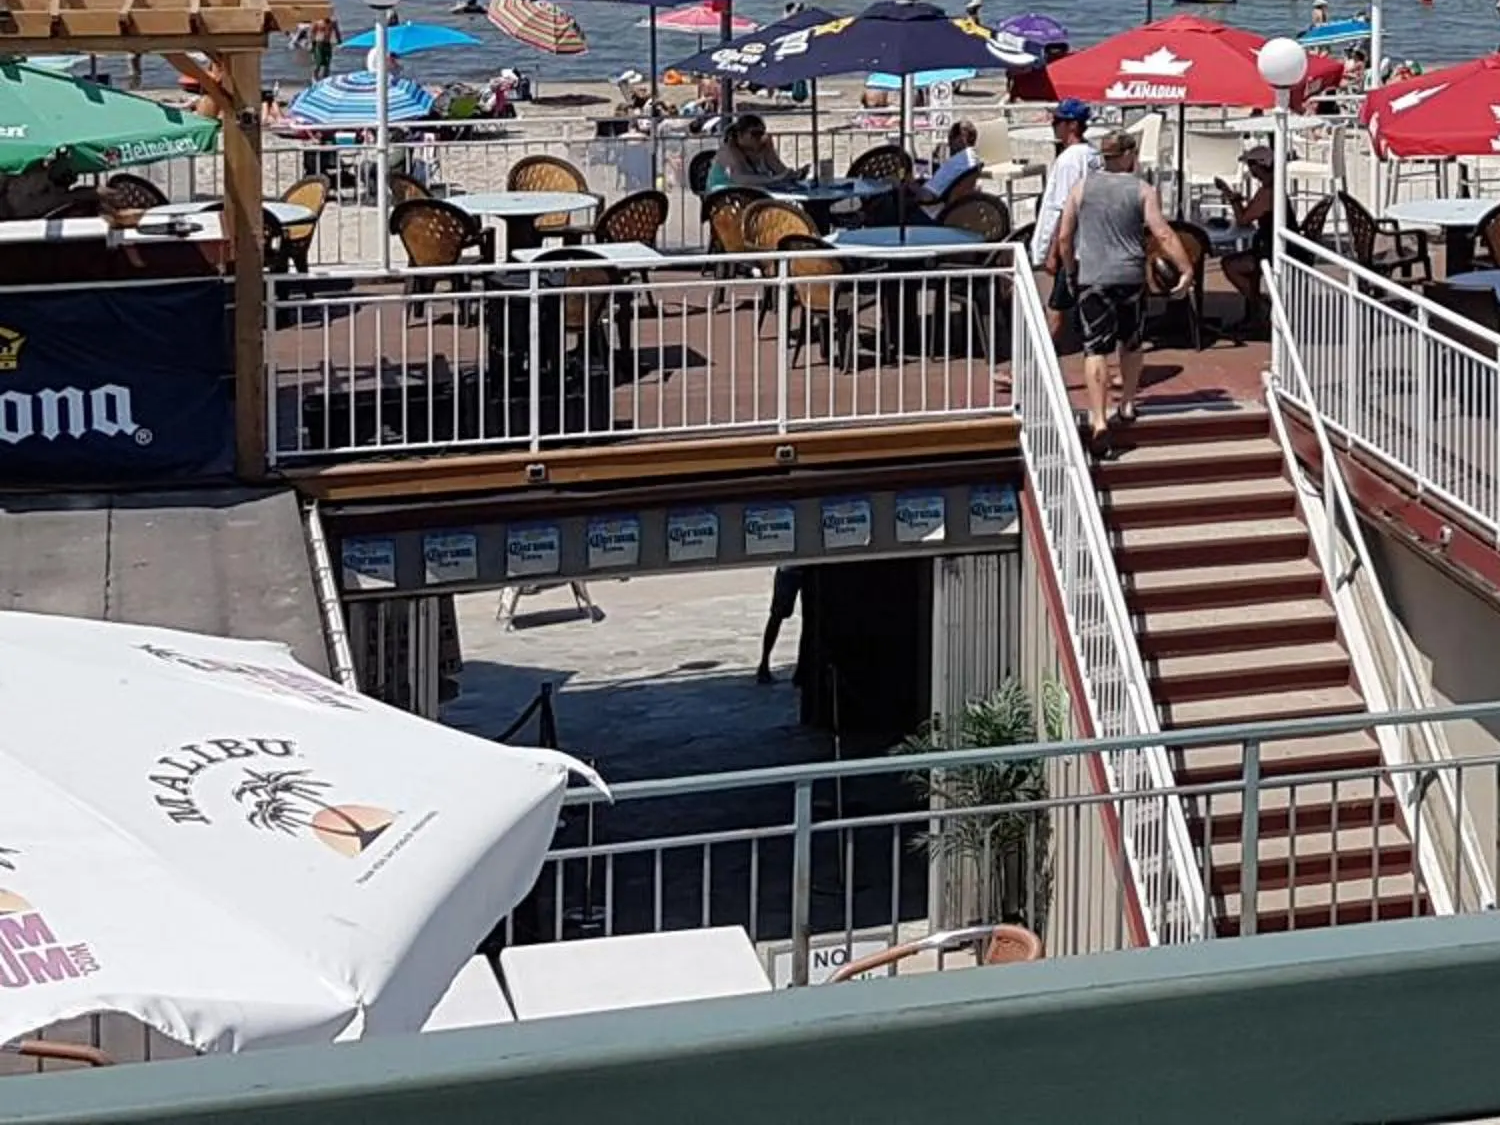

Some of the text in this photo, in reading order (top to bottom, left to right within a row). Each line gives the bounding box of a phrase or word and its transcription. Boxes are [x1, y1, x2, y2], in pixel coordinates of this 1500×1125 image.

[119, 134, 198, 164] Heineken
[149, 738, 297, 825] MALIBU
[814, 948, 848, 968] NO
